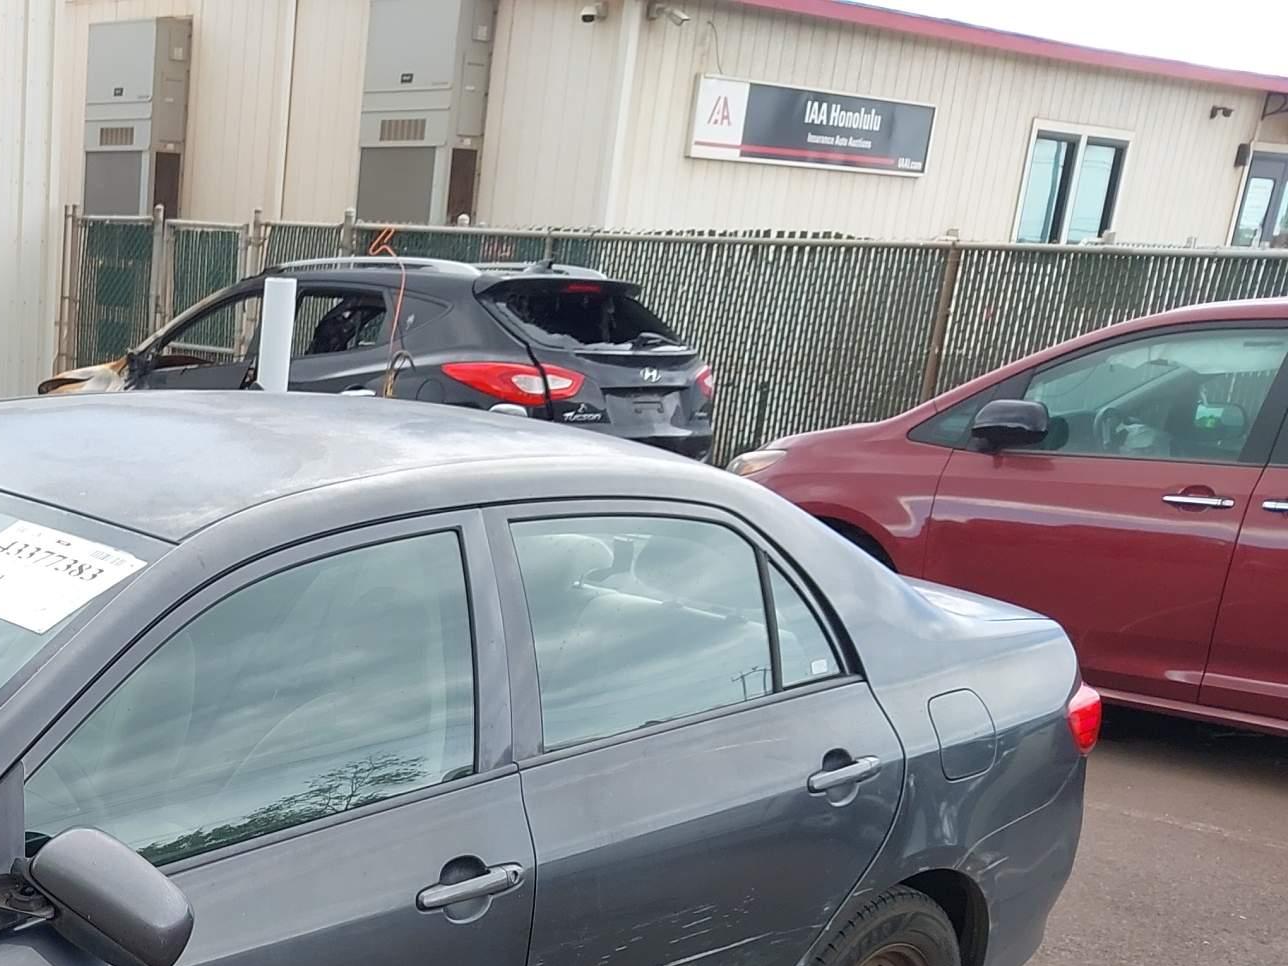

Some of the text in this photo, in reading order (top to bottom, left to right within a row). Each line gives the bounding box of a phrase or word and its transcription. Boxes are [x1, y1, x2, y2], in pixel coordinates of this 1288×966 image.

[804, 100, 882, 132] IAA Honolulu
[562, 411, 602, 422] Tucson
